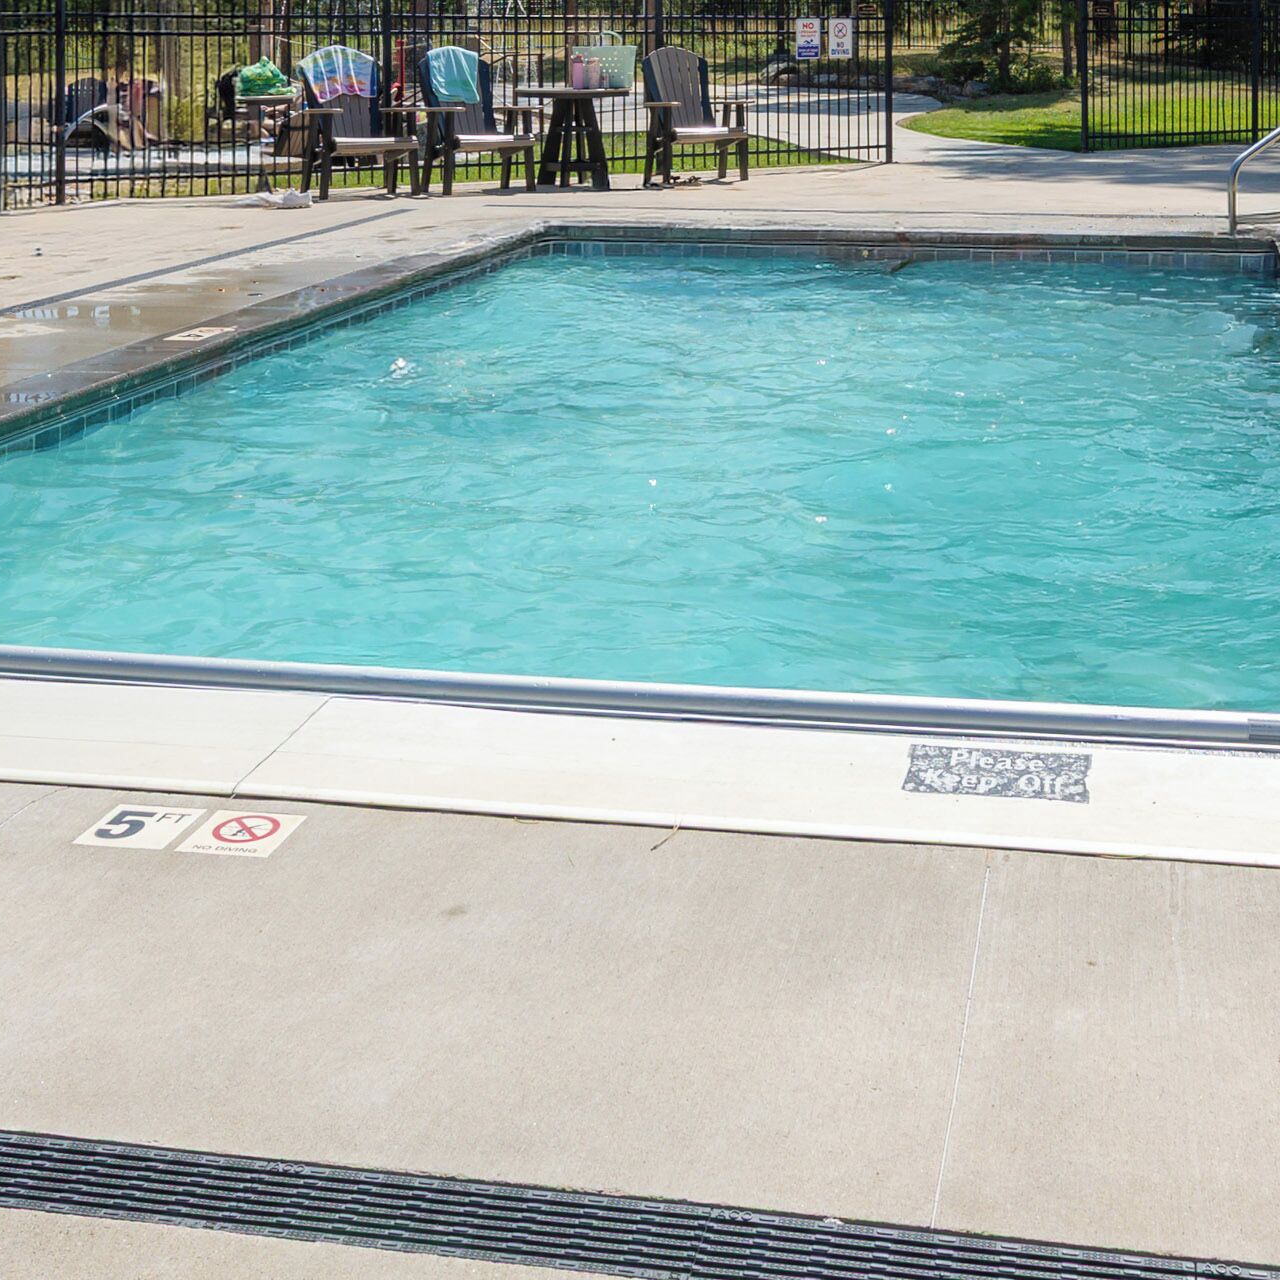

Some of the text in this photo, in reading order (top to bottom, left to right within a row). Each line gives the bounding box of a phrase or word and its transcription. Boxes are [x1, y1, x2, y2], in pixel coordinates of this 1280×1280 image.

[802, 22, 815, 30] NO
[949, 748, 1046, 771] Please
[924, 767, 999, 794] Keep
[94, 810, 193, 839] 5 FT
[215, 845, 258, 854] DIVING
